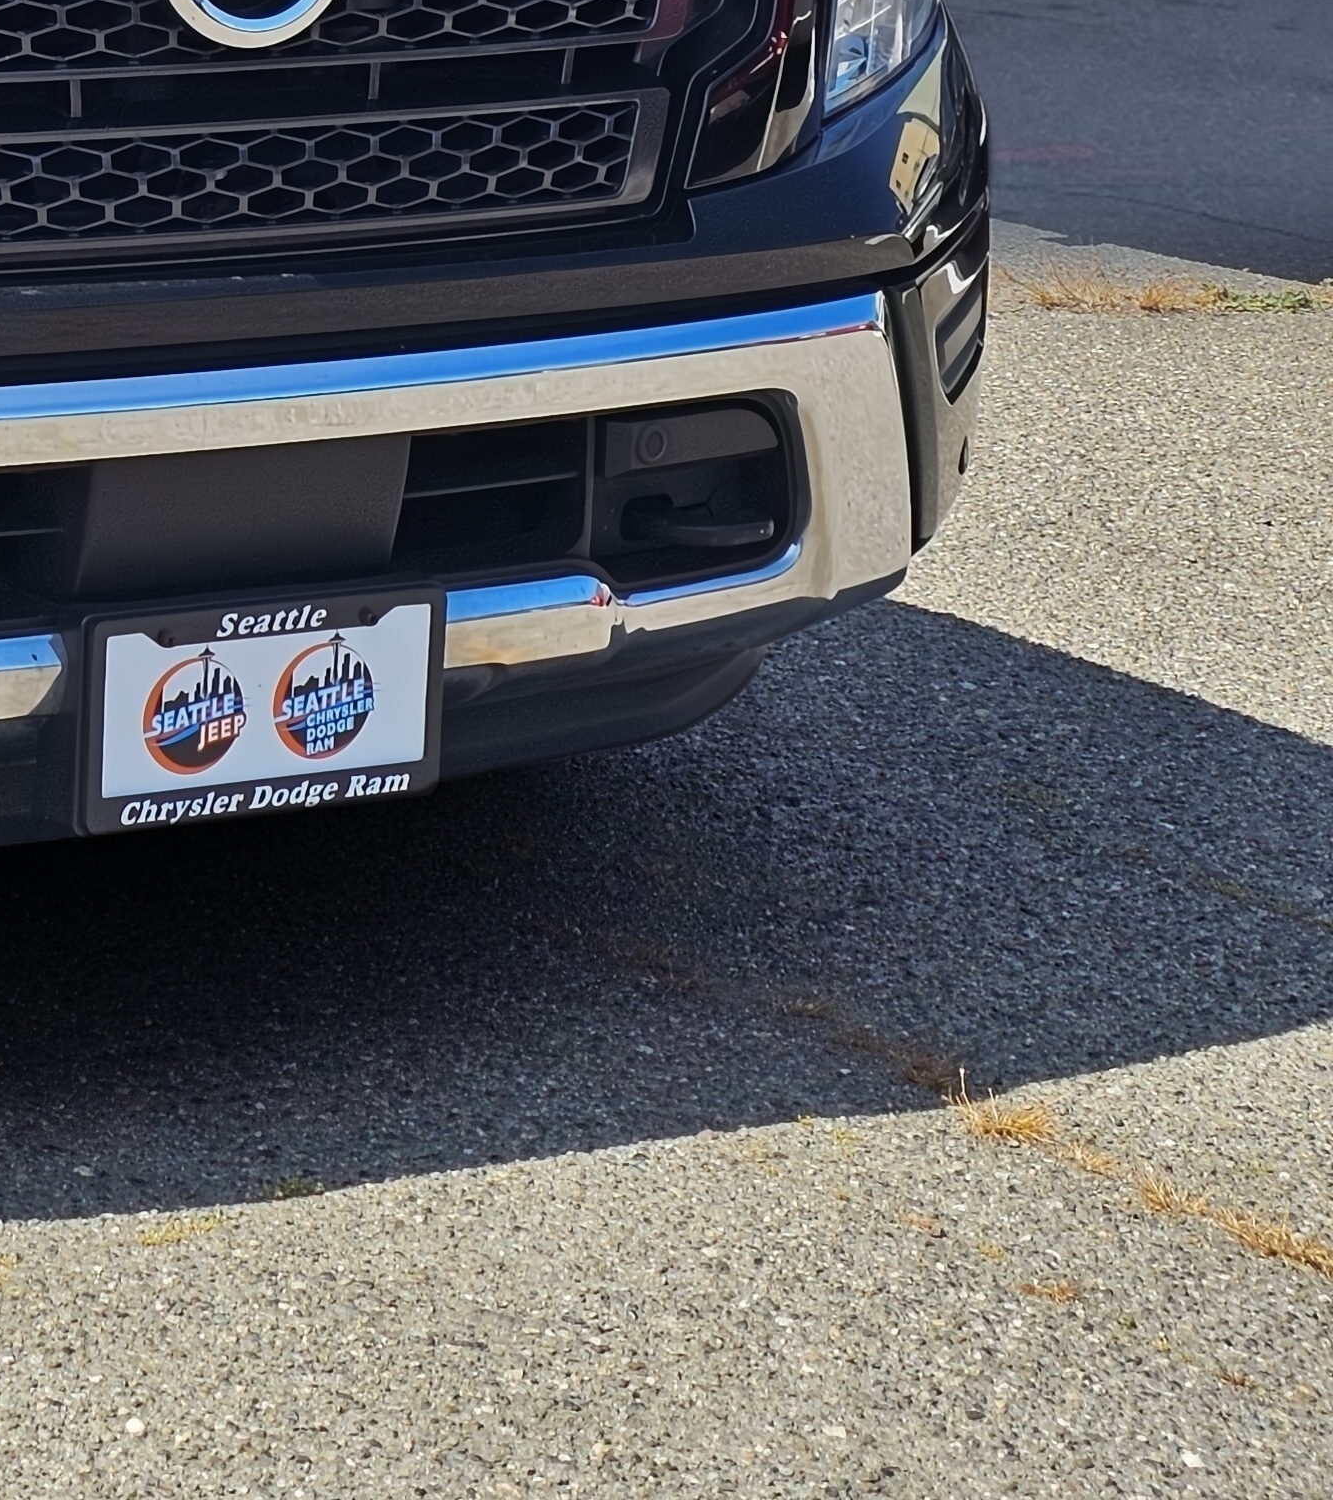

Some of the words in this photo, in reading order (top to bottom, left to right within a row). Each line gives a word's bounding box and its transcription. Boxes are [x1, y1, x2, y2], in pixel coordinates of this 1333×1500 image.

[215, 603, 328, 638] Seattle
[149, 692, 236, 737] SEATTLE
[280, 678, 365, 721] SEATTLE
[306, 697, 374, 727] CHRYSLER
[197, 714, 246, 752] JEEP
[305, 735, 335, 756] RAM
[306, 715, 355, 742] DODGE
[119, 790, 244, 826] Chrysler
[248, 779, 339, 808] Dodge
[344, 772, 411, 798] Ram
